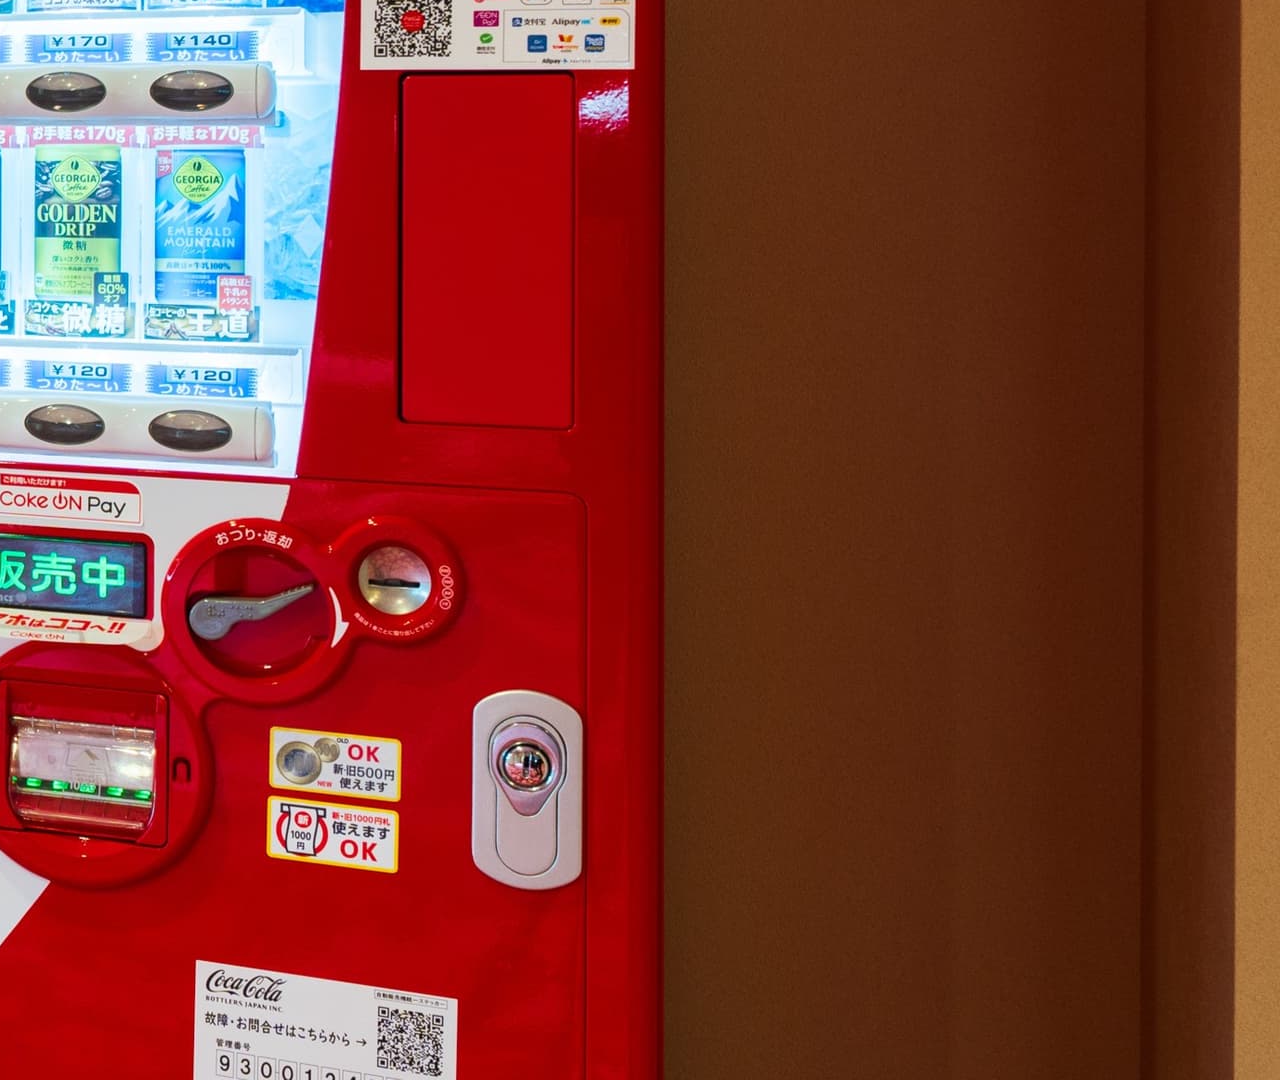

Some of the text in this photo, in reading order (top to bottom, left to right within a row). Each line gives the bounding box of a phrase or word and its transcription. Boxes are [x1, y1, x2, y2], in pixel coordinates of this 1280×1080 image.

[51, 35, 107, 48] ¥170
[172, 33, 231, 47] ¥140
[54, 174, 97, 183] GEORGIA
[176, 175, 220, 184] GEORGIA
[37, 204, 117, 223] GOLDEN
[55, 223, 96, 236] DRIP
[167, 227, 231, 237] EMERALD
[164, 237, 235, 248] MOUNTAIN
[98, 283, 126, 295] 60%
[185, 308, 249, 338] 王道
[52, 363, 108, 377] ¥120
[174, 368, 231, 382] ¥120
[0, 491, 126, 518] Coke ON Pay
[10, 631, 43, 639] Coke
[348, 744, 380, 763] OK
[340, 778, 388, 793] 使えます
[291, 830, 311, 841] 1000
[332, 821, 390, 840] 使えます
[297, 841, 305, 850] 円
[340, 839, 378, 862] OK
[205, 969, 288, 1002] Coca-Cola
[205, 1011, 350, 1047] 故障・お問合せはこちらから
[216, 1038, 251, 1051] 管理番号
